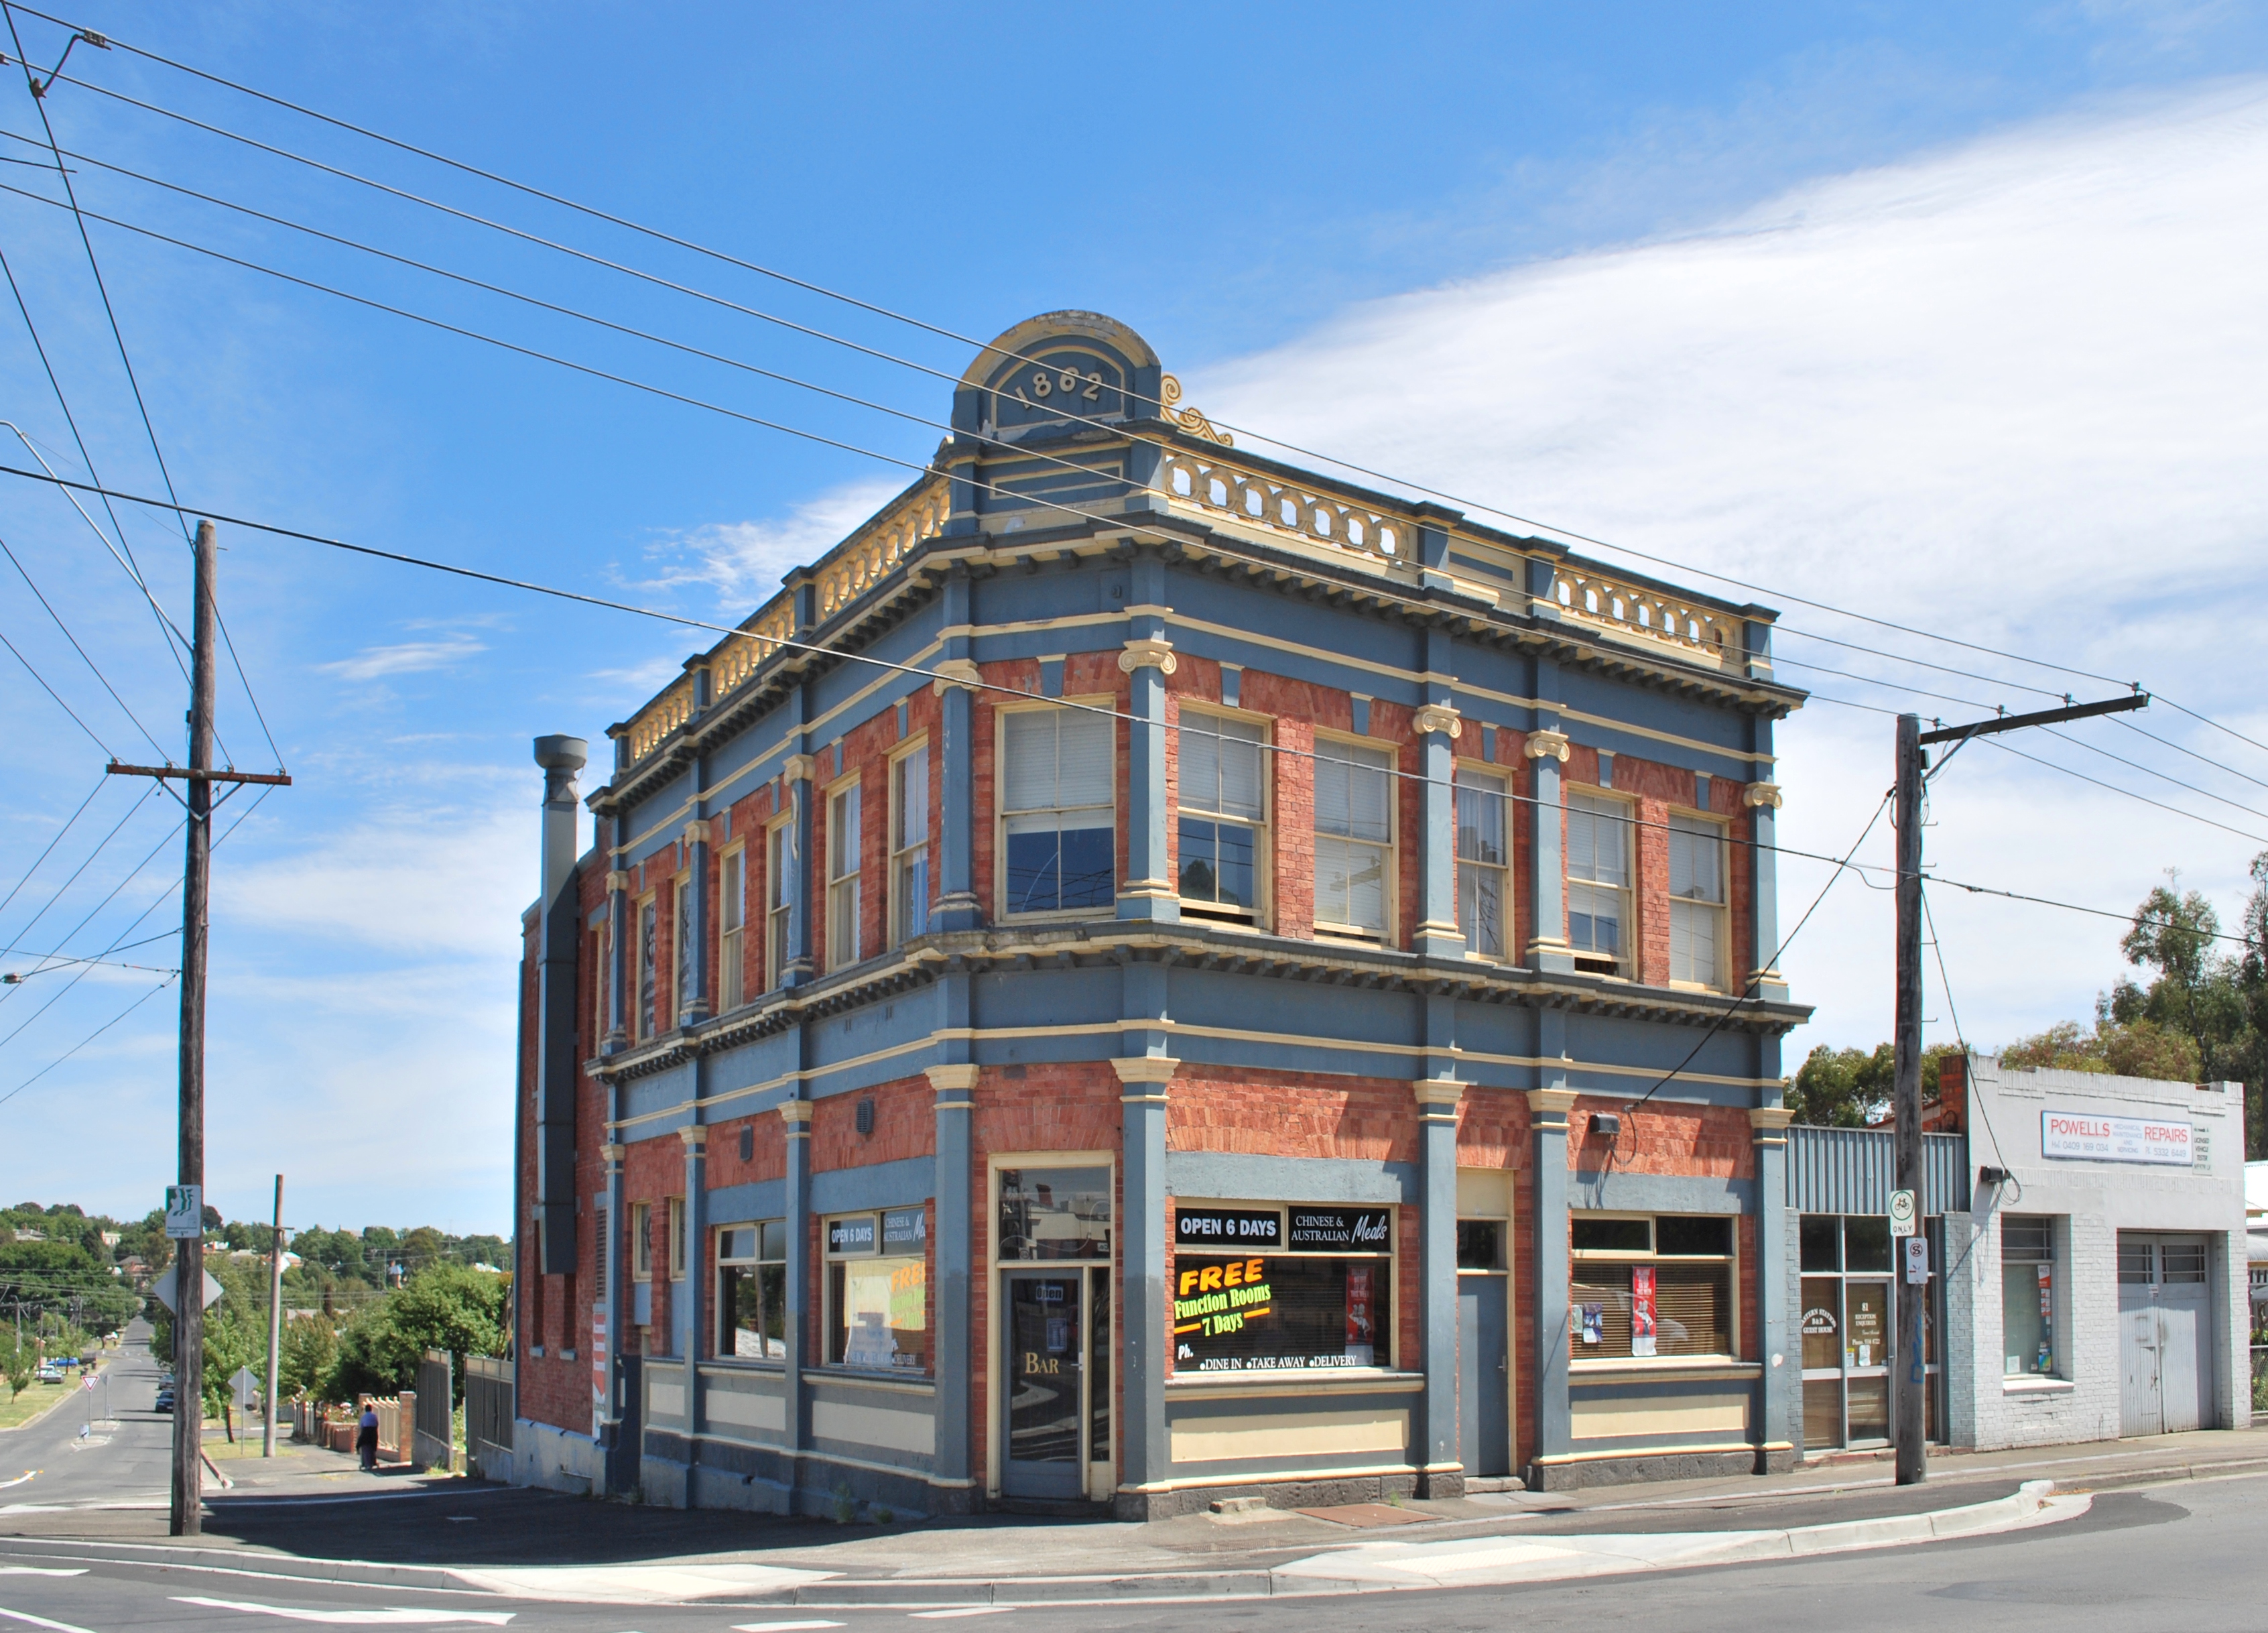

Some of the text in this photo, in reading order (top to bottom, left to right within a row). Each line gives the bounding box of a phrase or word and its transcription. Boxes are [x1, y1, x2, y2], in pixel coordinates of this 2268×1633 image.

[1015, 367, 1102, 410] 1862
[2051, 1119, 2110, 1137] POWELLS
[2113, 1124, 2141, 1132] MECHANICAL
[2113, 1131, 2143, 1139] MAINTENANCE
[2145, 1126, 2188, 1142] REPAIRS
[2062, 1141, 2080, 1150] 0409
[2083, 1142, 2094, 1151] 169
[2096, 1143, 2109, 1152] 034
[2153, 1148, 2169, 1157] 5332
[2171, 1148, 2186, 1158] 6449
[885, 1216, 909, 1228] CHINESE &
[1181, 1217, 1276, 1236] OPEN 6 DAYS
[1296, 1215, 1344, 1227] CHINESE &
[832, 1227, 873, 1243] OPEN 6 DAYS
[883, 1230, 912, 1242] AUSTRALIAN
[1291, 1215, 1387, 1243] AUSTRALIAN Meals
[1893, 1225, 1913, 1233] ONLY
[1180, 1258, 1263, 1295] FREE
[1037, 1286, 1062, 1299] Open
[1174, 1284, 1271, 1319] Function Rooms
[1861, 1303, 1869, 1311] 81
[1202, 1313, 1243, 1337] 7 Days
[1178, 1343, 1194, 1360] Ph.
[894, 1353, 916, 1365] DELIVERY
[1205, 1355, 1357, 1370] DINE IN TAKE AWAY DELIVERY
